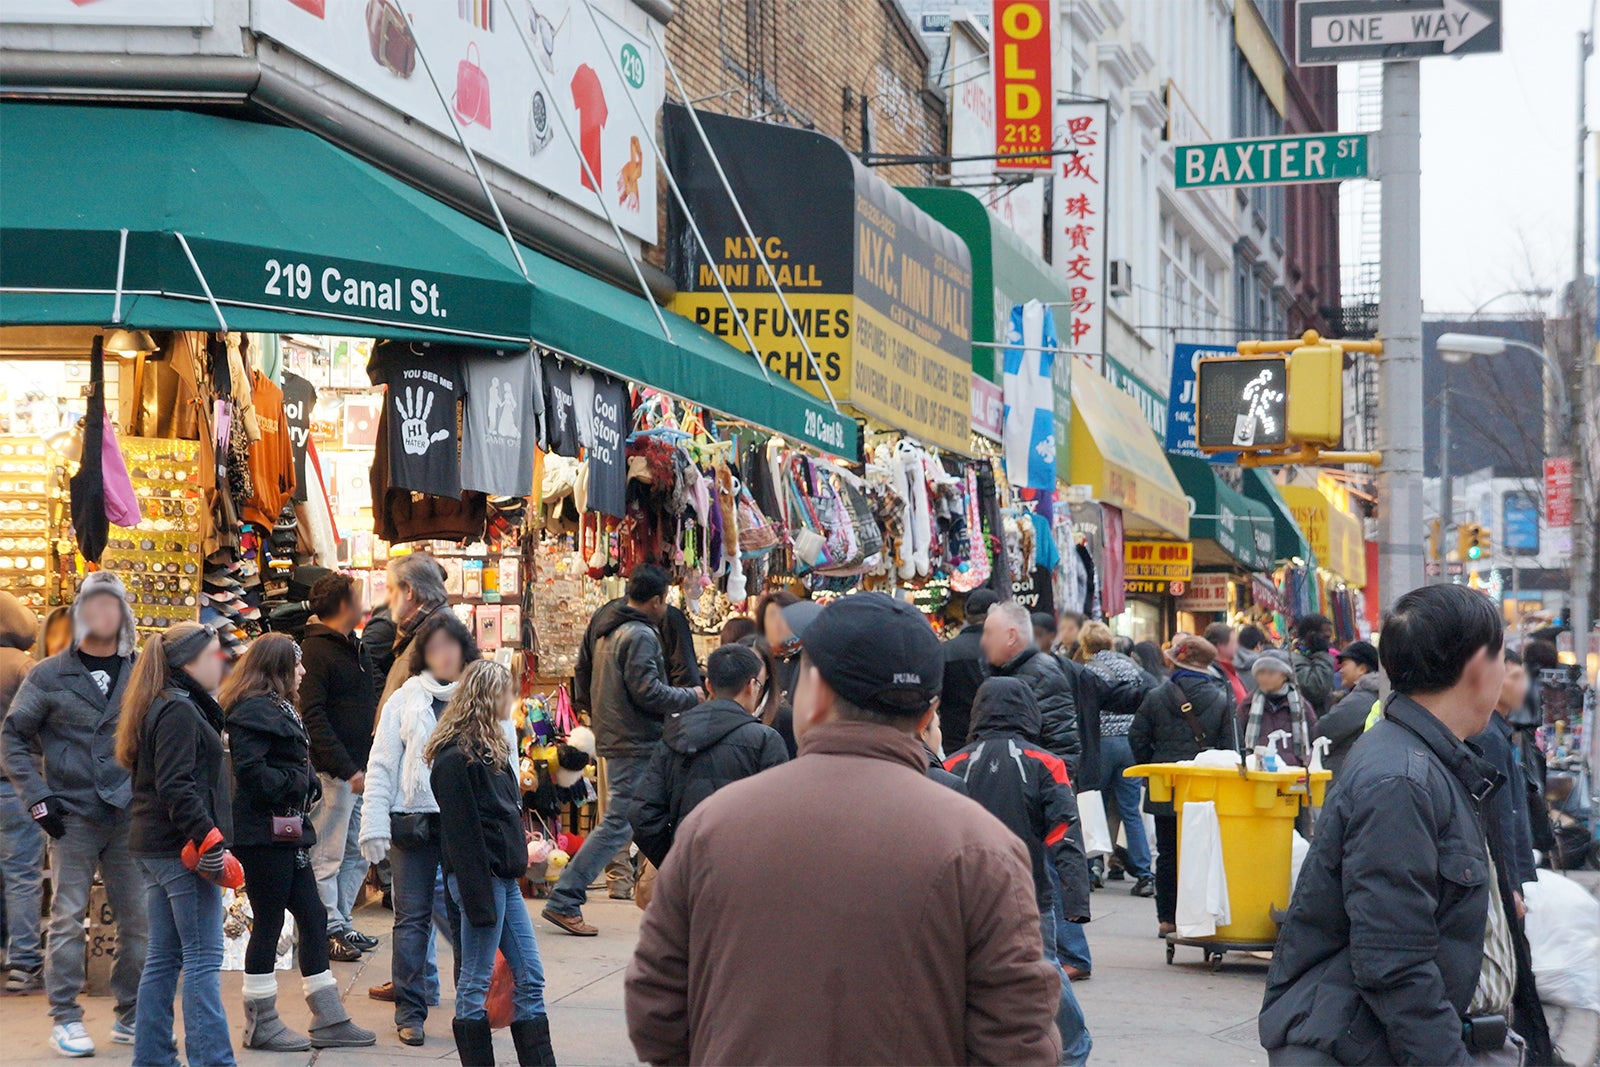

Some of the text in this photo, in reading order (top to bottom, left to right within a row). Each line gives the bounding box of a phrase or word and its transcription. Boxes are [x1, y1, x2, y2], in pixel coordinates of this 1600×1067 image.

[1327, 11, 1470, 43] ONE WAY
[623, 48, 642, 85] 219
[1003, 124, 1042, 144] 213
[997, 144, 1049, 165] CANAL
[1185, 138, 1359, 184] BAXTER ST
[724, 236, 789, 259] N.Y.C.
[700, 264, 823, 287] MINI MALL
[859, 222, 898, 299] N.Y.C.
[901, 253, 930, 319] MINI
[932, 274, 968, 341] MALL
[264, 258, 447, 318] 219 Canal St.
[695, 307, 850, 338] PERFUMES
[748, 350, 842, 381] CHES
[403, 369, 453, 391] YOU SEE ME
[284, 400, 303, 420] ol
[594, 393, 617, 422] Cool
[407, 423, 422, 438] HI
[593, 417, 620, 450] Story
[804, 408, 845, 449] 219 Canal St.
[405, 439, 426, 448] HATER
[592, 439, 613, 465] Bro.
[1131, 546, 1188, 560] BUY GOLD
[1012, 577, 1034, 593] ool
[893, 673, 921, 684] PUMA
